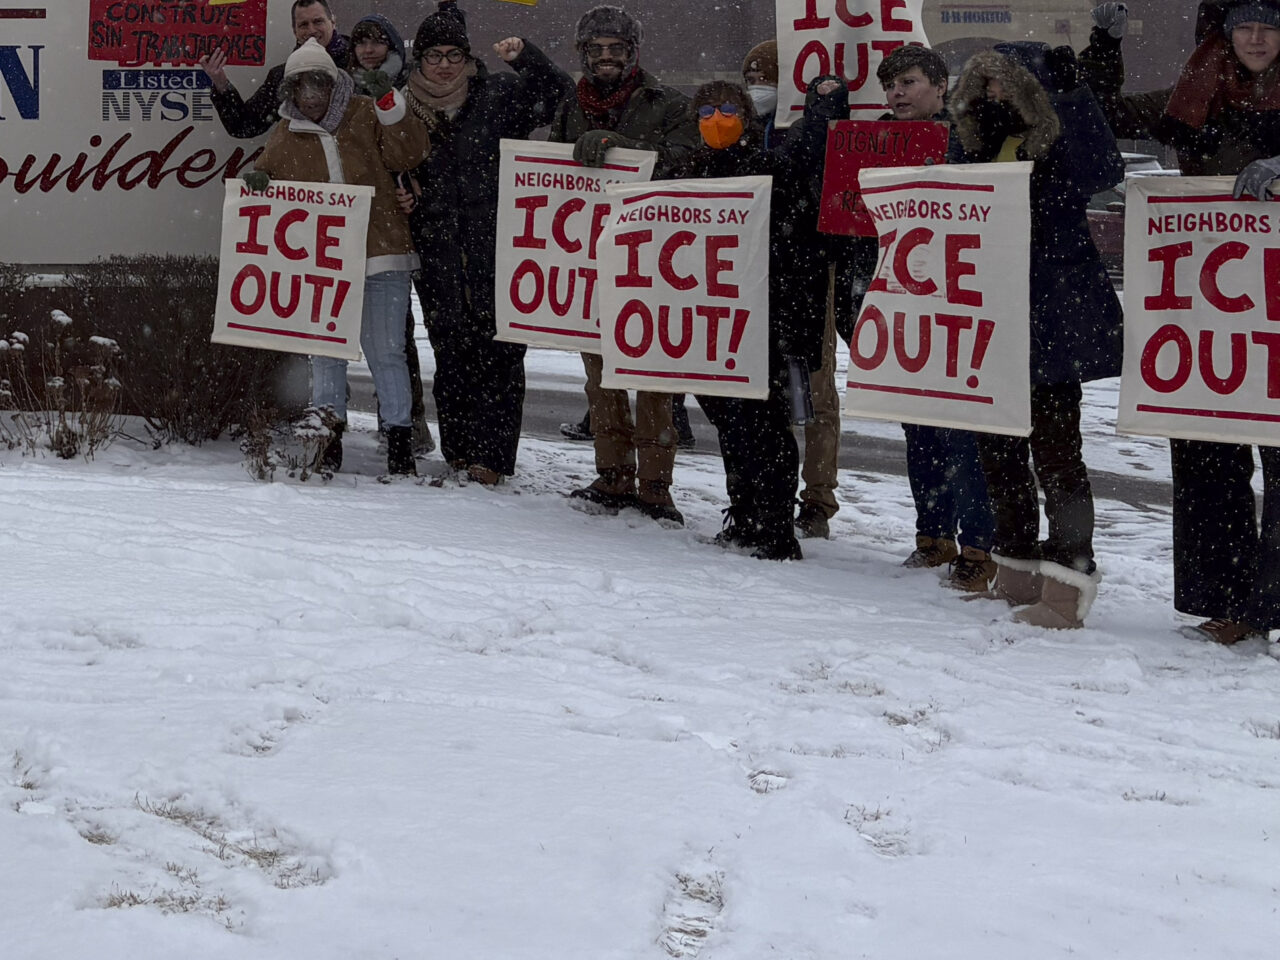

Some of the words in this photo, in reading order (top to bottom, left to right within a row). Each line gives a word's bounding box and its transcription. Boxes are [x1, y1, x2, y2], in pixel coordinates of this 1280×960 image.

[106, 3, 242, 26] CONSTRUYE
[91, 21, 122, 48] SIN
[120, 71, 198, 88] Listed
[793, 40, 924, 94] OU
[102, 91, 213, 122] NYSE
[834, 130, 912, 155] DIGNITY
[514, 172, 600, 193] NEIGHBORS
[328, 193, 357, 208] SAY
[958, 203, 991, 222] SAY
[616, 206, 712, 224] NEIGHBORS
[717, 209, 749, 225] SAY
[1148, 212, 1271, 236] NEIGHBORS
[236, 205, 346, 271] ICE
[615, 229, 739, 298] ICE
[230, 264, 352, 332] OUT!
[509, 259, 601, 328] OUT
[614, 299, 750, 370] OUT!
[849, 304, 996, 389] OUT!
[1140, 324, 1280, 399] OUT
